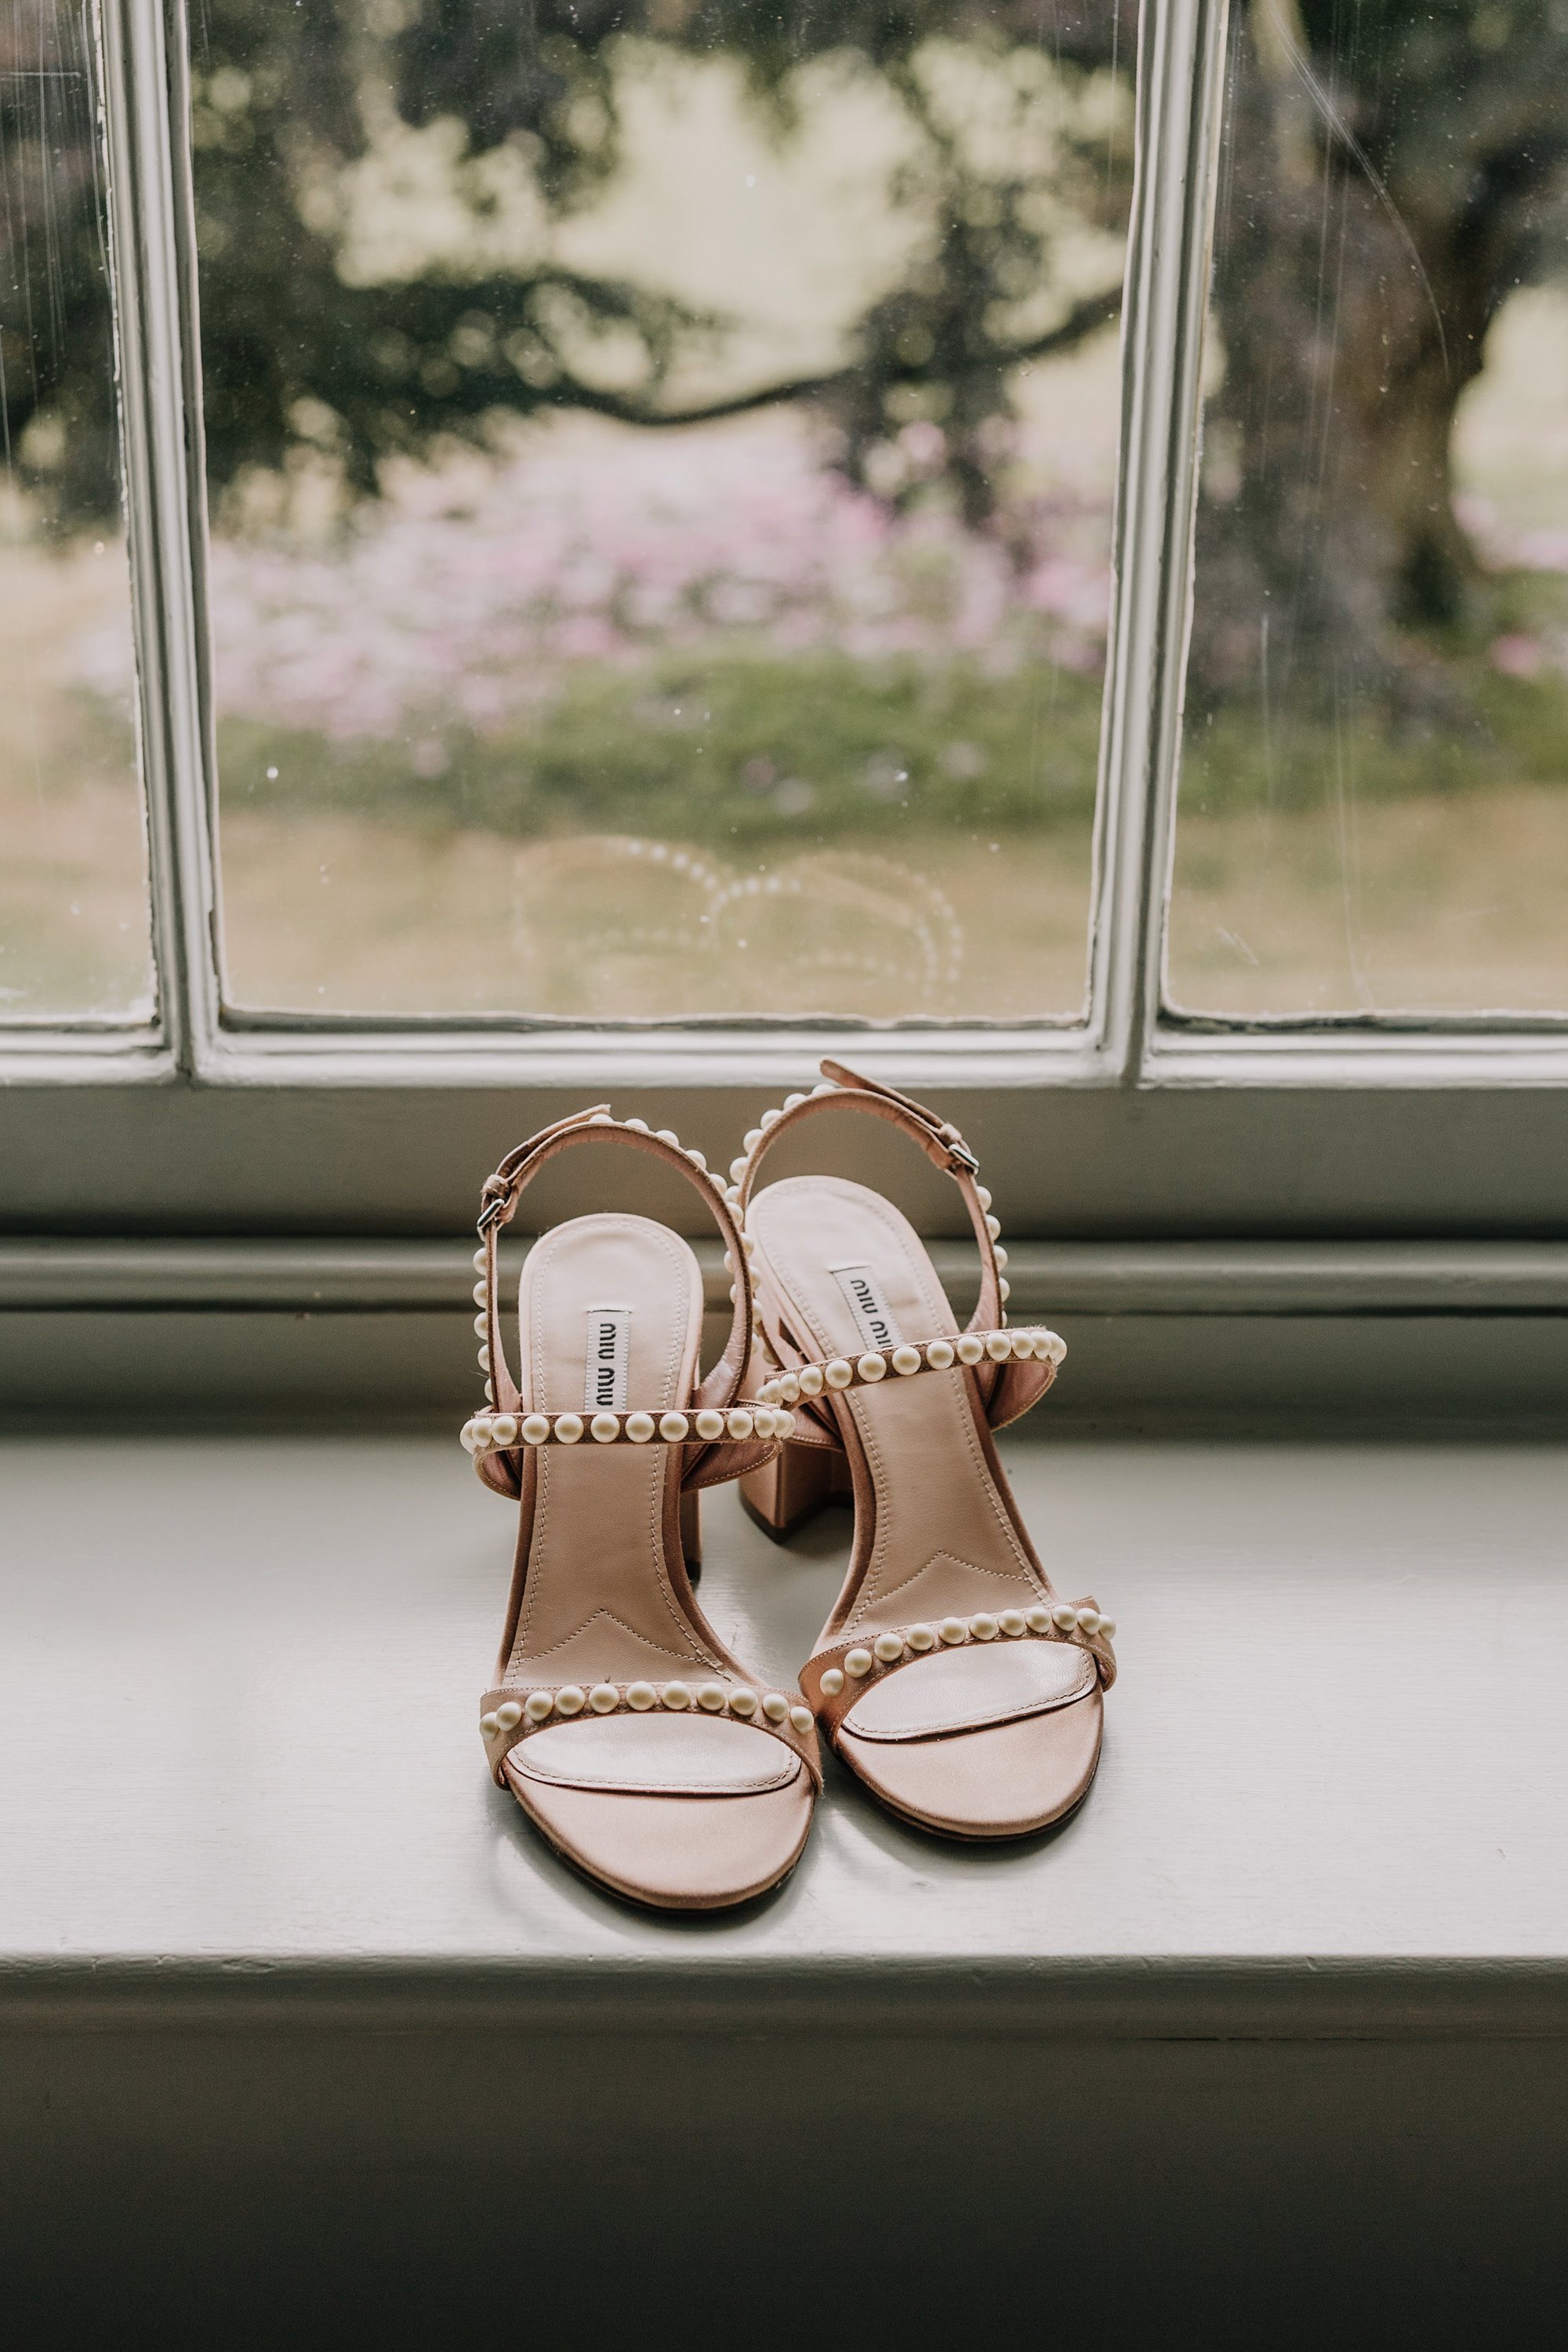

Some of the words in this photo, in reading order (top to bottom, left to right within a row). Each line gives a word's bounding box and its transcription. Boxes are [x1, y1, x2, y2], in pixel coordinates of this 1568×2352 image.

[851, 1279, 878, 1313] miu
[598, 1323, 616, 1359] miu
[596, 1367, 615, 1406] miu
